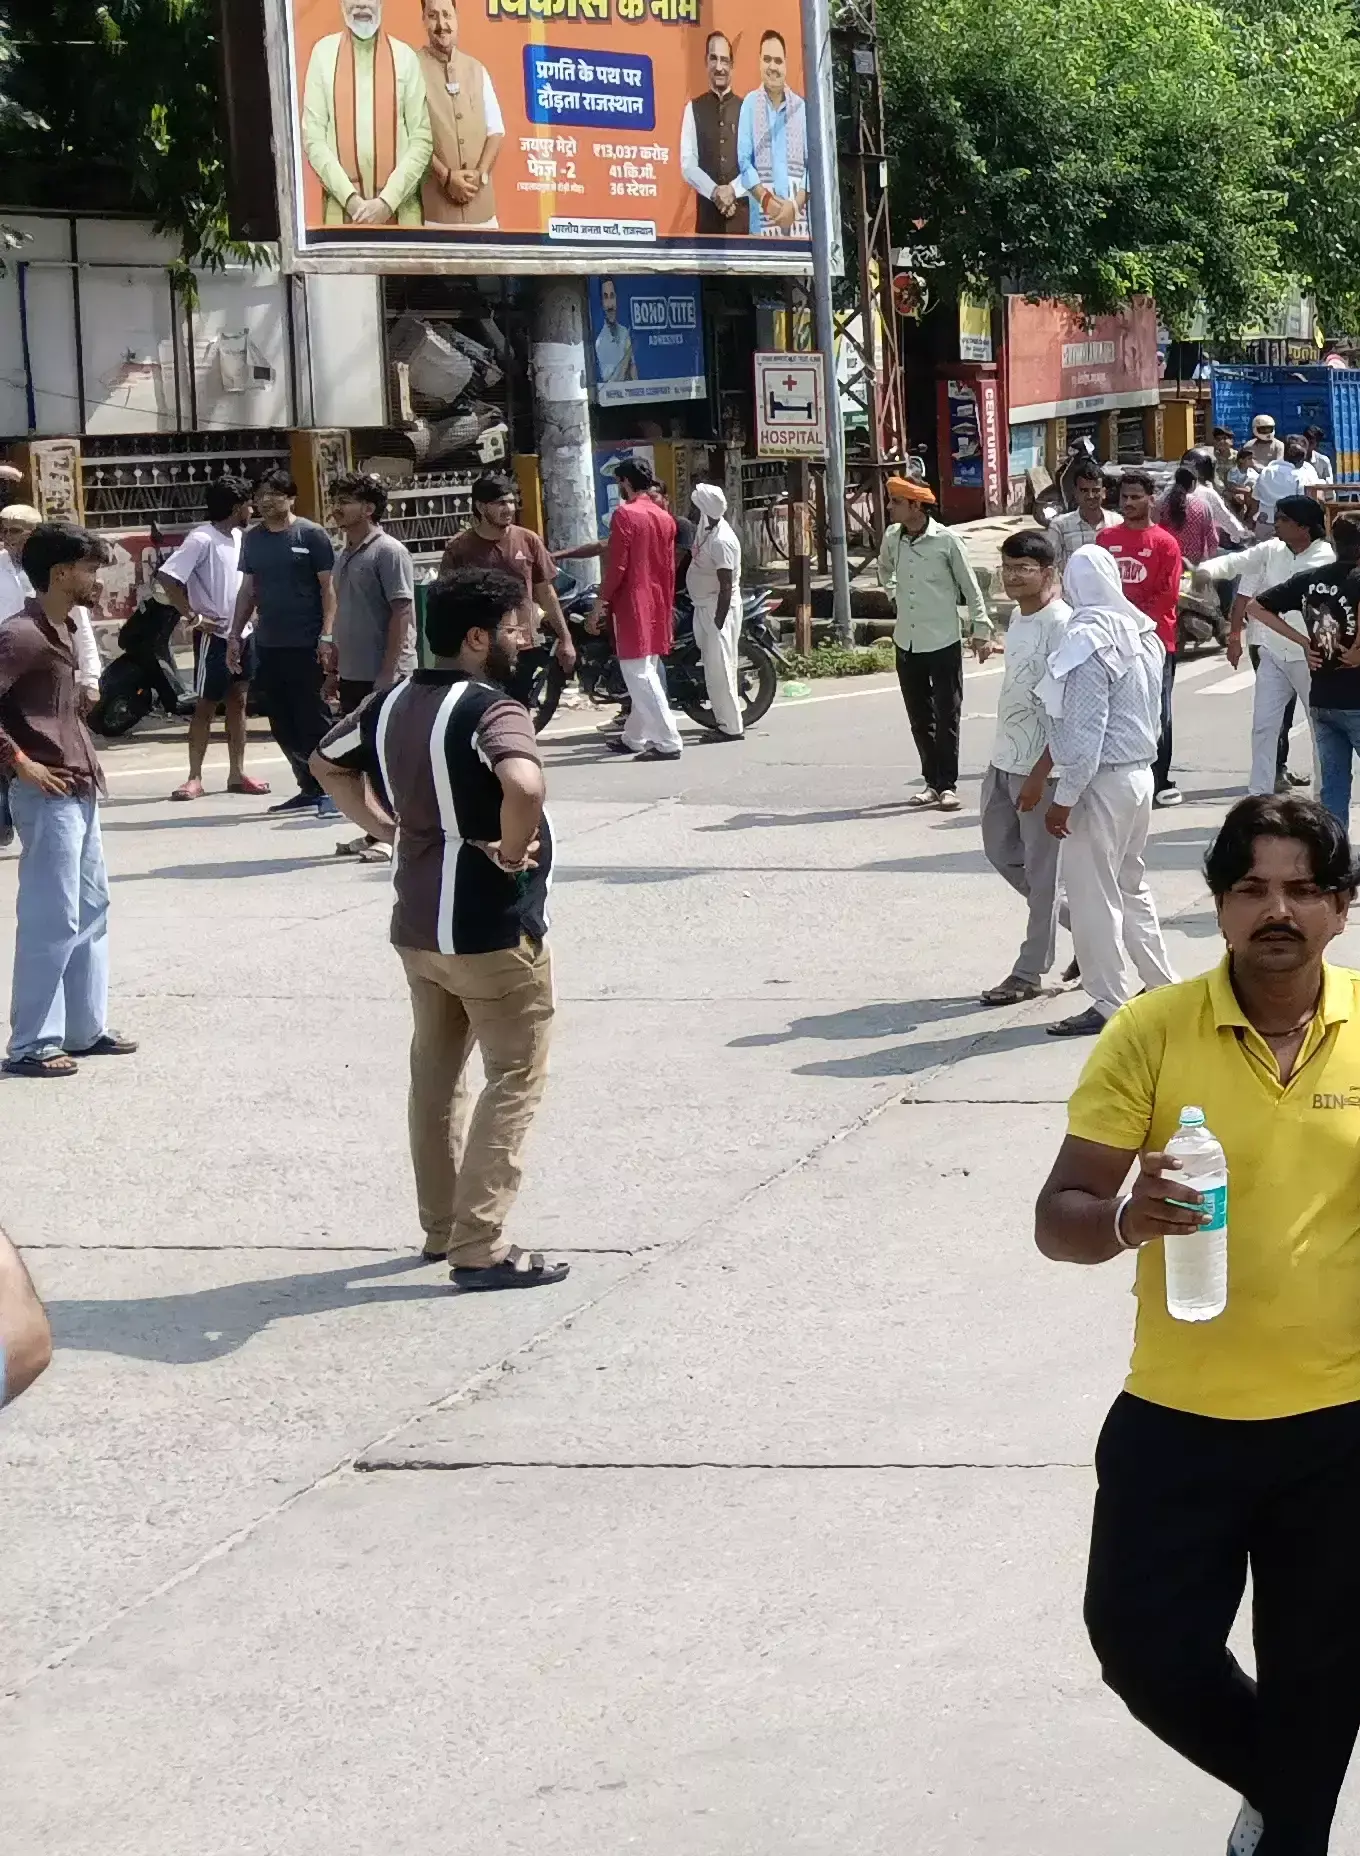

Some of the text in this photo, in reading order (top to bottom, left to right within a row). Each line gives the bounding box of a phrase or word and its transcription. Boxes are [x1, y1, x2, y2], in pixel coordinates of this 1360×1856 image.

[536, 58, 642, 87] प्रगति के पथ पर
[537, 83, 644, 114] दौड़ता राजस्थान
[518, 135, 577, 158] जयपुर मेट्रो
[639, 142, 669, 165] करोड़
[609, 166, 623, 179] 41
[609, 181, 657, 197] 36 स्टेशन
[551, 222, 654, 237] भारतीय जनता पार्टी, राजस्थान
[632, 299, 696, 325] BOND TITE
[760, 430, 824, 445] HOSPITAL
[985, 388, 999, 505] CENTURY PLY
[1308, 582, 1338, 596] POLO
[1338, 595, 1356, 636] RALPH
